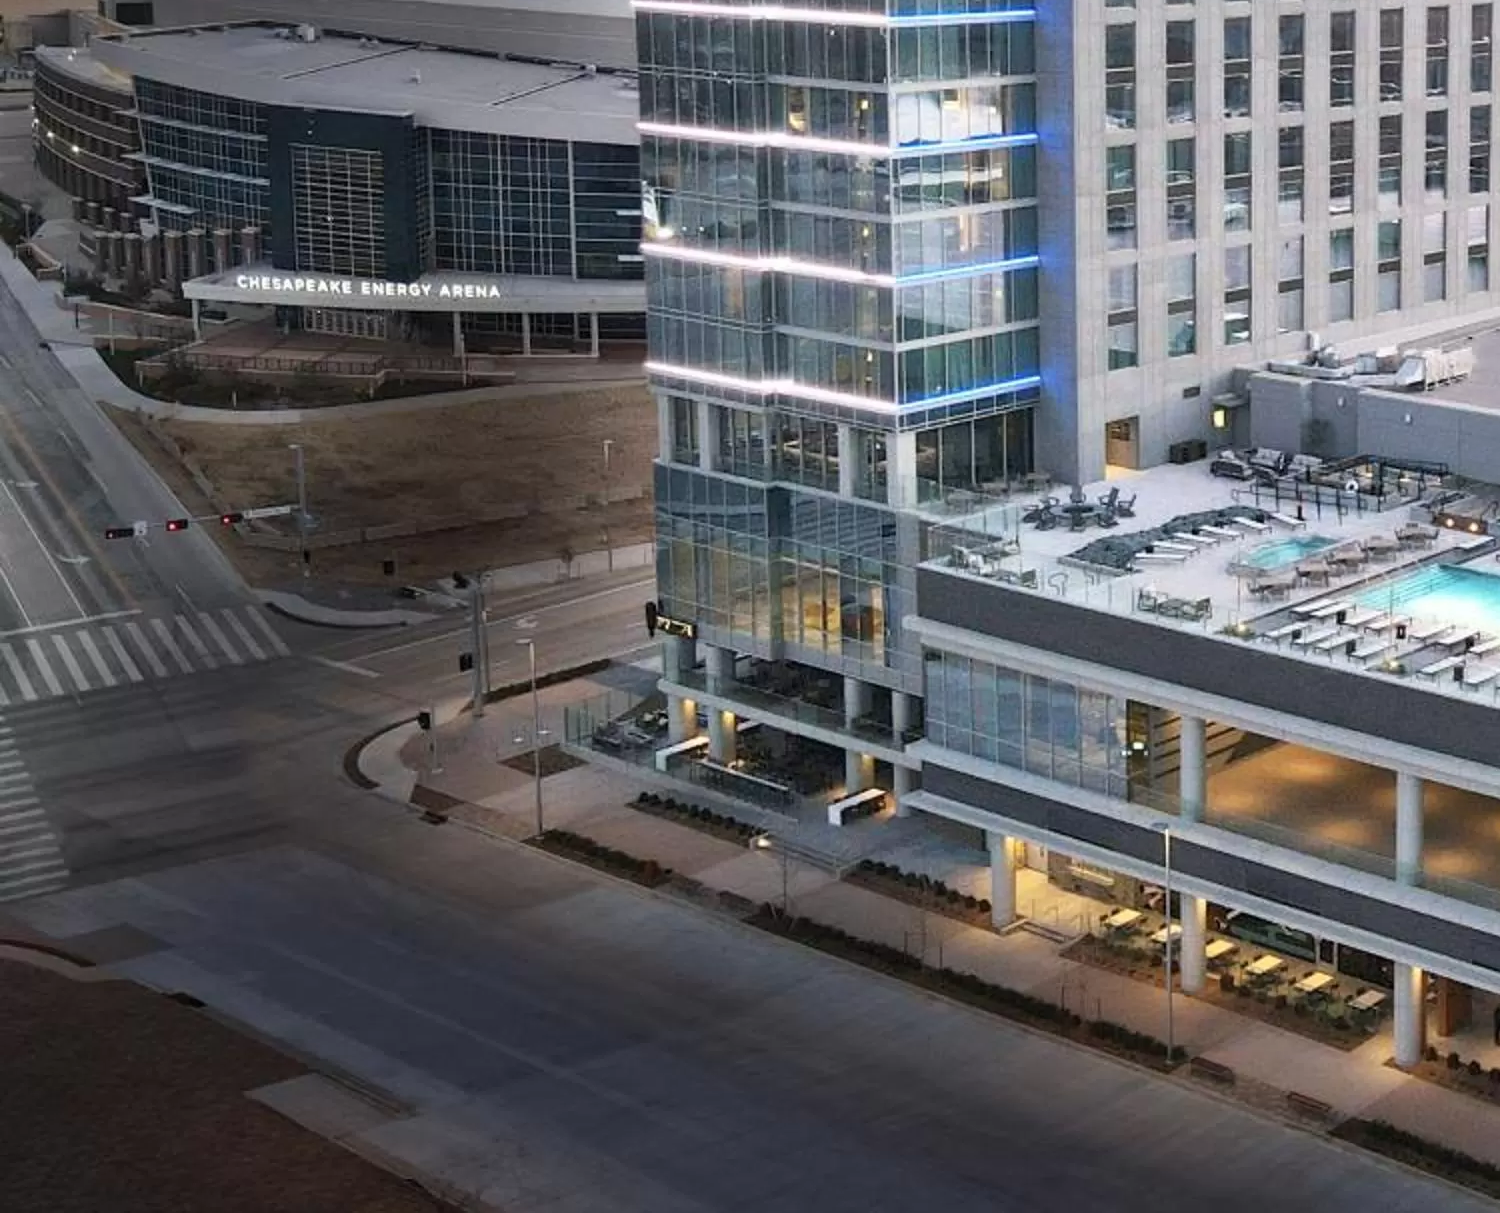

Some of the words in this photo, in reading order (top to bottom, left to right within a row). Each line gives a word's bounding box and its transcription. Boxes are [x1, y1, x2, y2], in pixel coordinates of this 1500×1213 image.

[237, 274, 352, 295] CHESAPEAKE
[361, 281, 432, 297] ENERGY
[440, 284, 500, 298] ARENA
